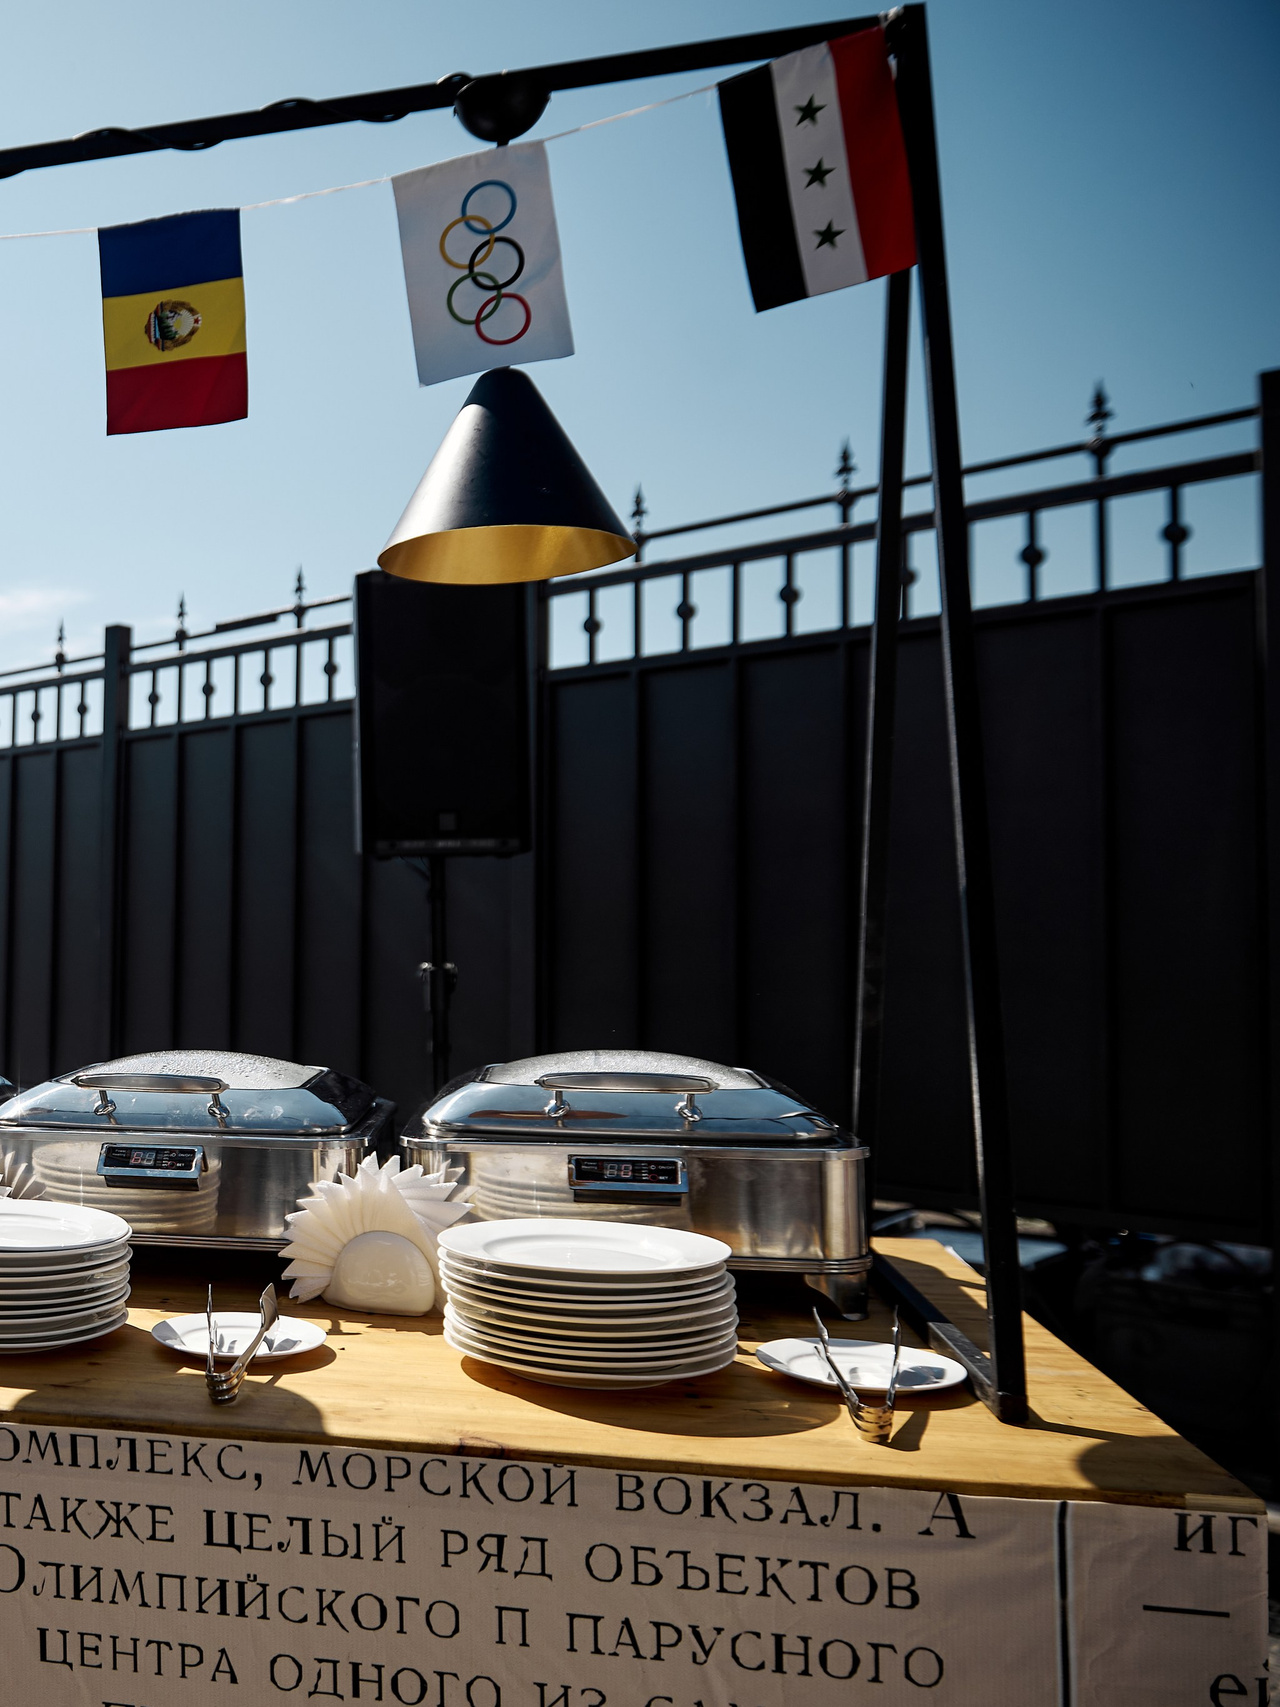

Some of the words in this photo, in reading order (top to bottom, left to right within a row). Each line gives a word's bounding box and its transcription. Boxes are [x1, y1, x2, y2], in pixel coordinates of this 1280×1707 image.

[292, 1450, 578, 1507] МОРСКОЙ
[615, 1474, 881, 1533] ВОКЗАЛ.
[918, 1492, 977, 1540] А
[1174, 1512, 1257, 1556] ИГ
[203, 1509, 406, 1564] ЦЕЛЫЙ
[440, 1529, 553, 1581] РЯД
[585, 1543, 919, 1609] ОБЪЕКТОВ
[37, 1627, 238, 1684] ЦЕНТРА
[270, 1654, 501, 1707] ОДНОГО
[495, 1606, 530, 1647] П
[566, 1613, 944, 1688] ПАРУСНОГО
